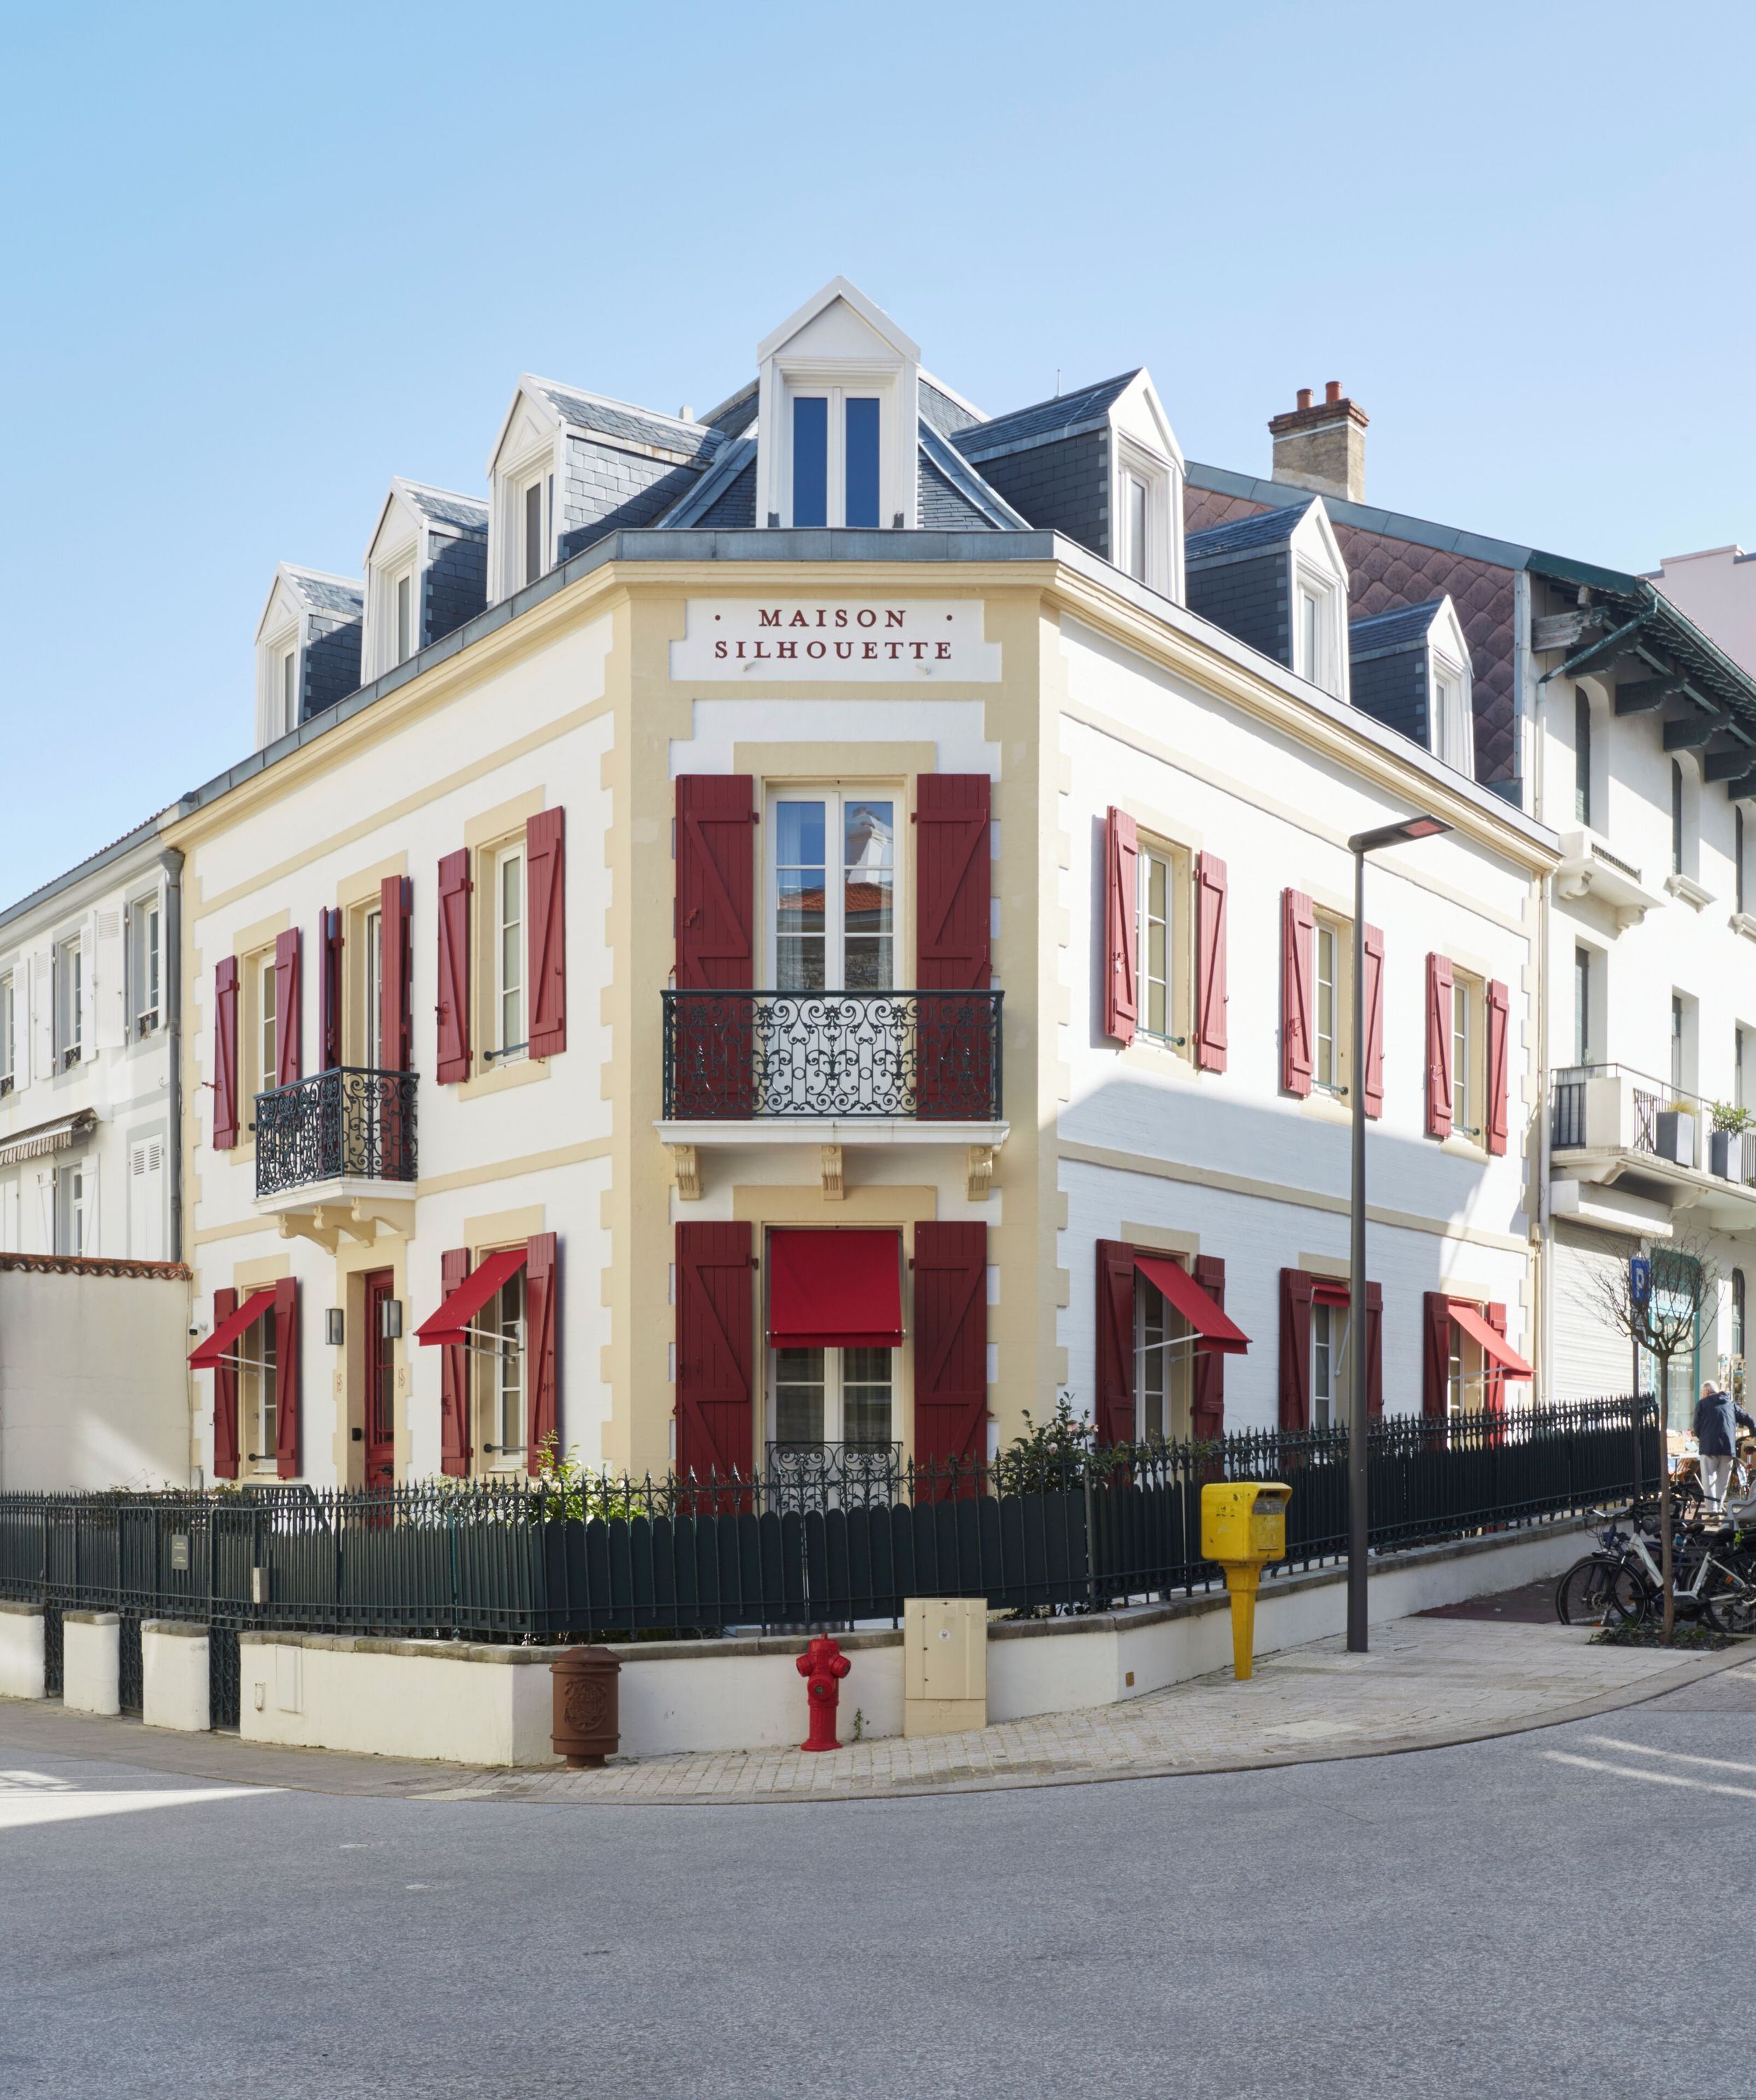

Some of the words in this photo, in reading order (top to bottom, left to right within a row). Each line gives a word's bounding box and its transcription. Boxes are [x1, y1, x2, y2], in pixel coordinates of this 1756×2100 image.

[758, 609, 906, 628] MAISON
[715, 640, 952, 659] SILHOUETTE
[1636, 1268, 1645, 1298] P
